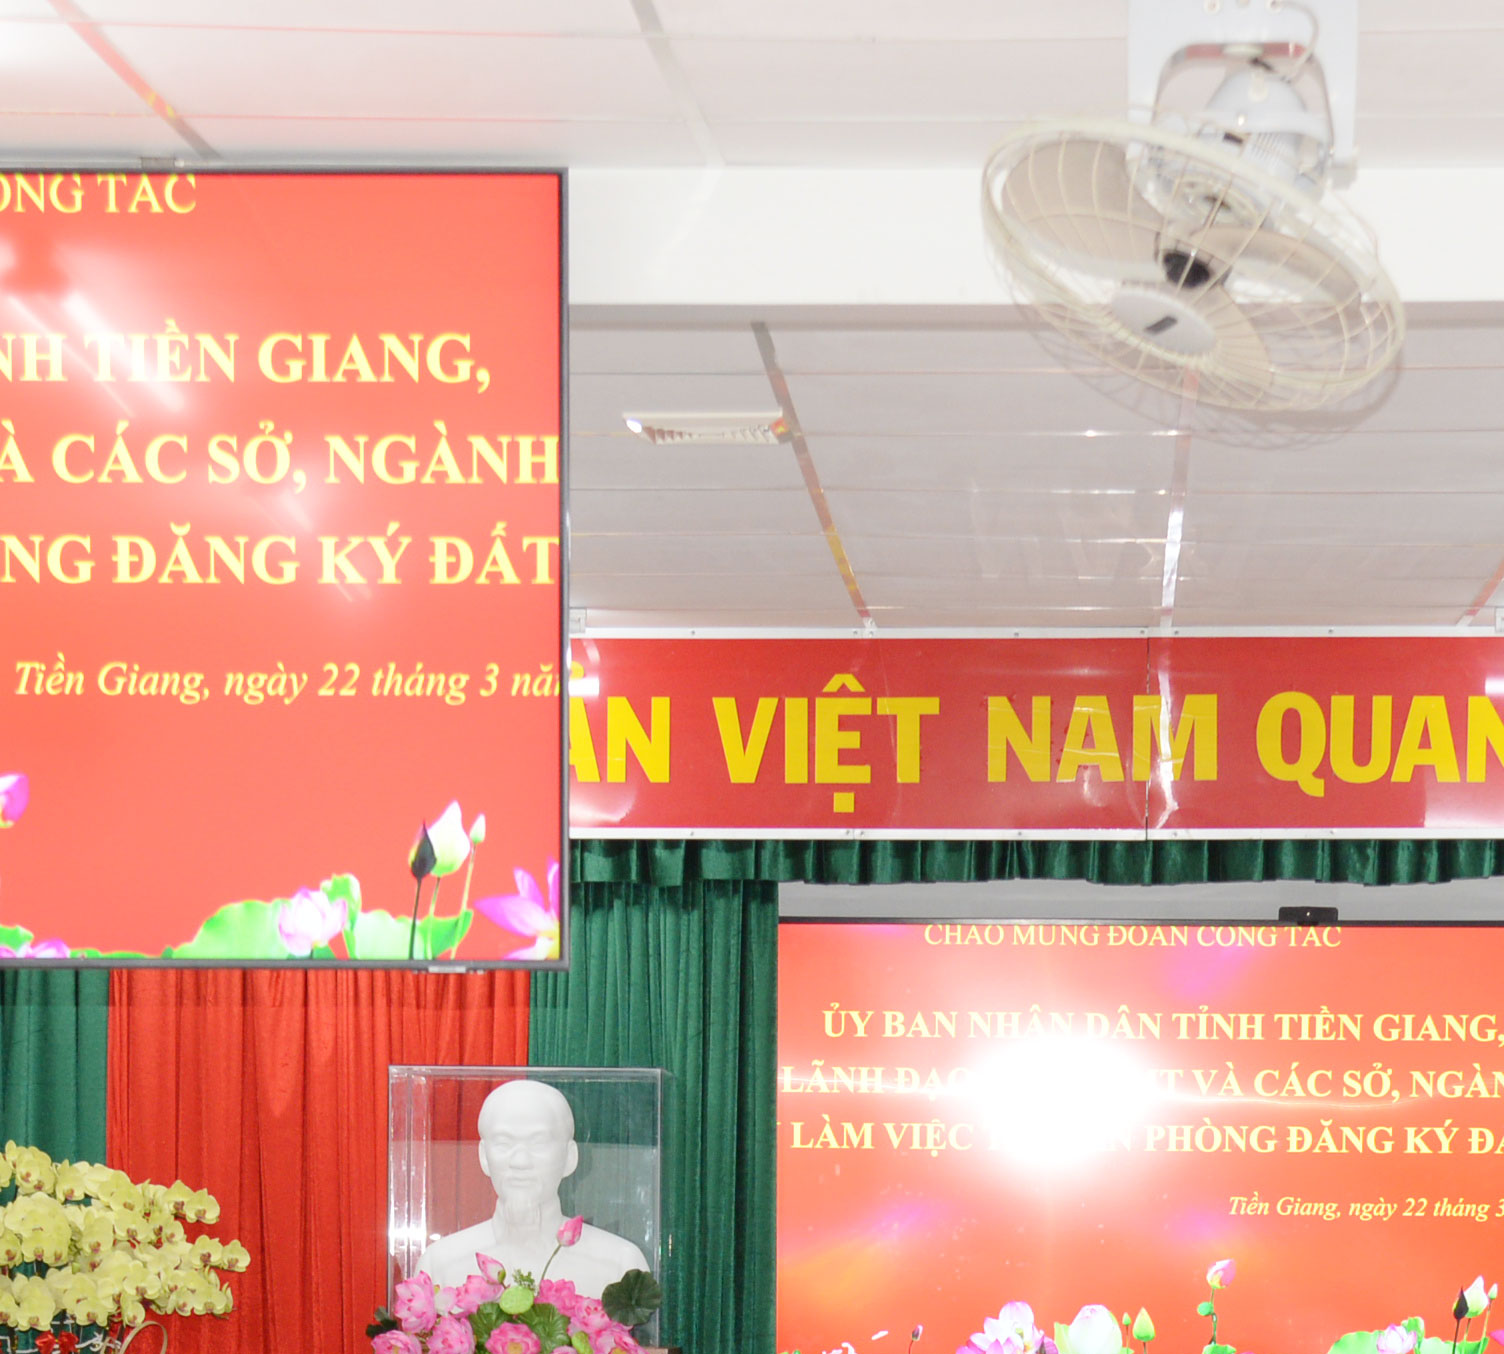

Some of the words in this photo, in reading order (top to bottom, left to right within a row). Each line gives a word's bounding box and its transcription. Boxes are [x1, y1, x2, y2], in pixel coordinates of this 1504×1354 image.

[84, 317, 239, 383] TIỀN
[257, 331, 492, 393] GIANG,
[50, 420, 189, 485] CÁC
[207, 420, 306, 494] SỞ,
[325, 419, 561, 485] NGÀNH
[111, 521, 300, 585] ĐĂNG
[319, 521, 412, 585] KÝ
[428, 520, 561, 585] ĐẤT
[15, 650, 86, 697] Tiền
[96, 660, 211, 705] Giang,
[224, 660, 310, 706] ngày
[317, 661, 361, 697] 22
[371, 660, 470, 706] tháng
[479, 661, 501, 698] 3
[712, 673, 940, 813] VIỆT
[988, 694, 1218, 783] NAM
[822, 1002, 873, 1037] ỦY
[882, 1010, 958, 1038] BAN
[967, 1006, 1075, 1039] NHÂN
[1083, 1008, 1163, 1040] DÂN
[1171, 1004, 1265, 1041] TỈNH
[1274, 1005, 1363, 1041] TIỀN
[780, 1059, 887, 1093] LÃNH
[1193, 1062, 1244, 1097] VÀ
[1253, 1062, 1333, 1097] CÁC
[1343, 1062, 1401, 1104] SỞ,
[790, 1113, 876, 1149] LÀM
[882, 1118, 974, 1158] VIỆC
[1143, 1117, 1278, 1153] PHÒNG
[1285, 1119, 1394, 1154] ĐĂNG
[1404, 1119, 1459, 1154] KÝ
[1229, 1191, 1270, 1216] Tiền
[1275, 1196, 1342, 1221] Giang,
[1348, 1197, 1398, 1222] ngày
[1402, 1197, 1426, 1217] 22
[1432, 1197, 1491, 1222] tháng
